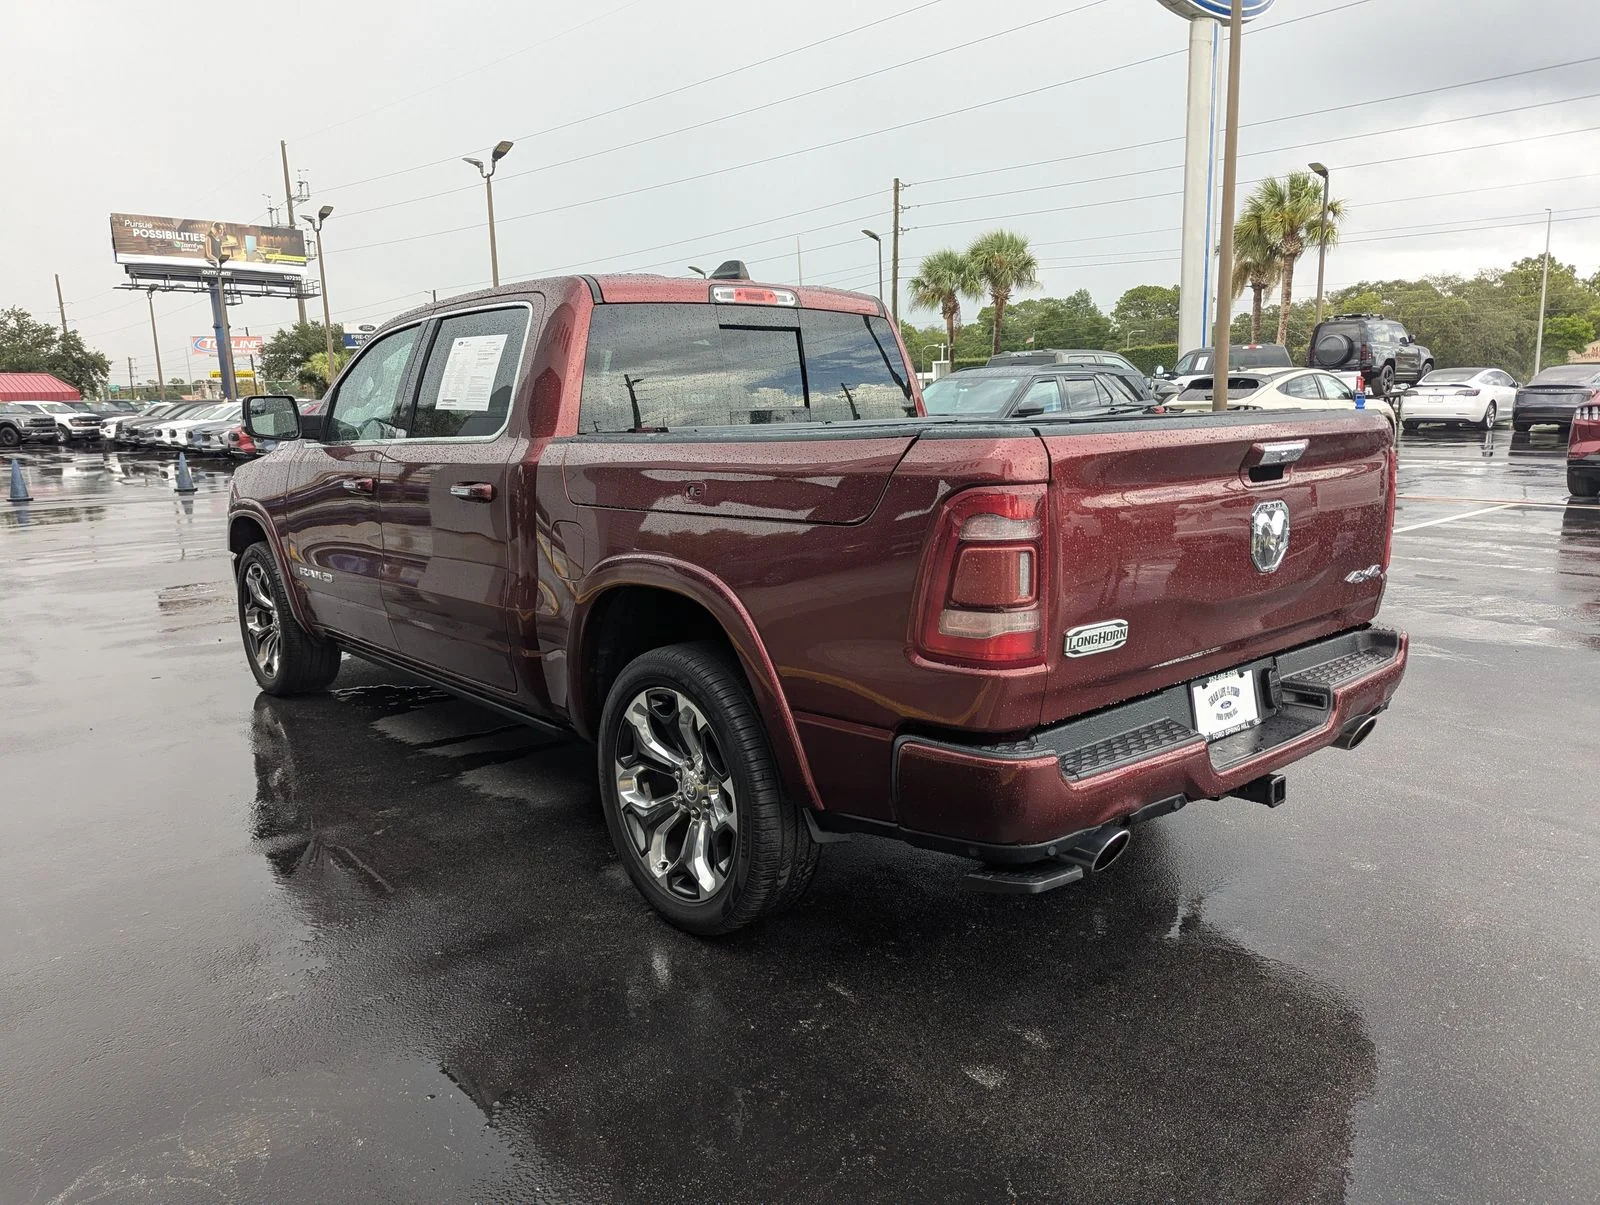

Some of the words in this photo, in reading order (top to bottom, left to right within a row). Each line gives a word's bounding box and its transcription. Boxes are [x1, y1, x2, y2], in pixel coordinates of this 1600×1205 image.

[124, 219, 153, 229] Pursue
[132, 228, 206, 243] POSSIBILITIES
[205, 339, 262, 349] TOLINE
[1068, 628, 1127, 650] LONGHORN
[1212, 730, 1225, 740] FORD
[1225, 724, 1240, 736] SPRING
[1241, 722, 1250, 730] HILL
